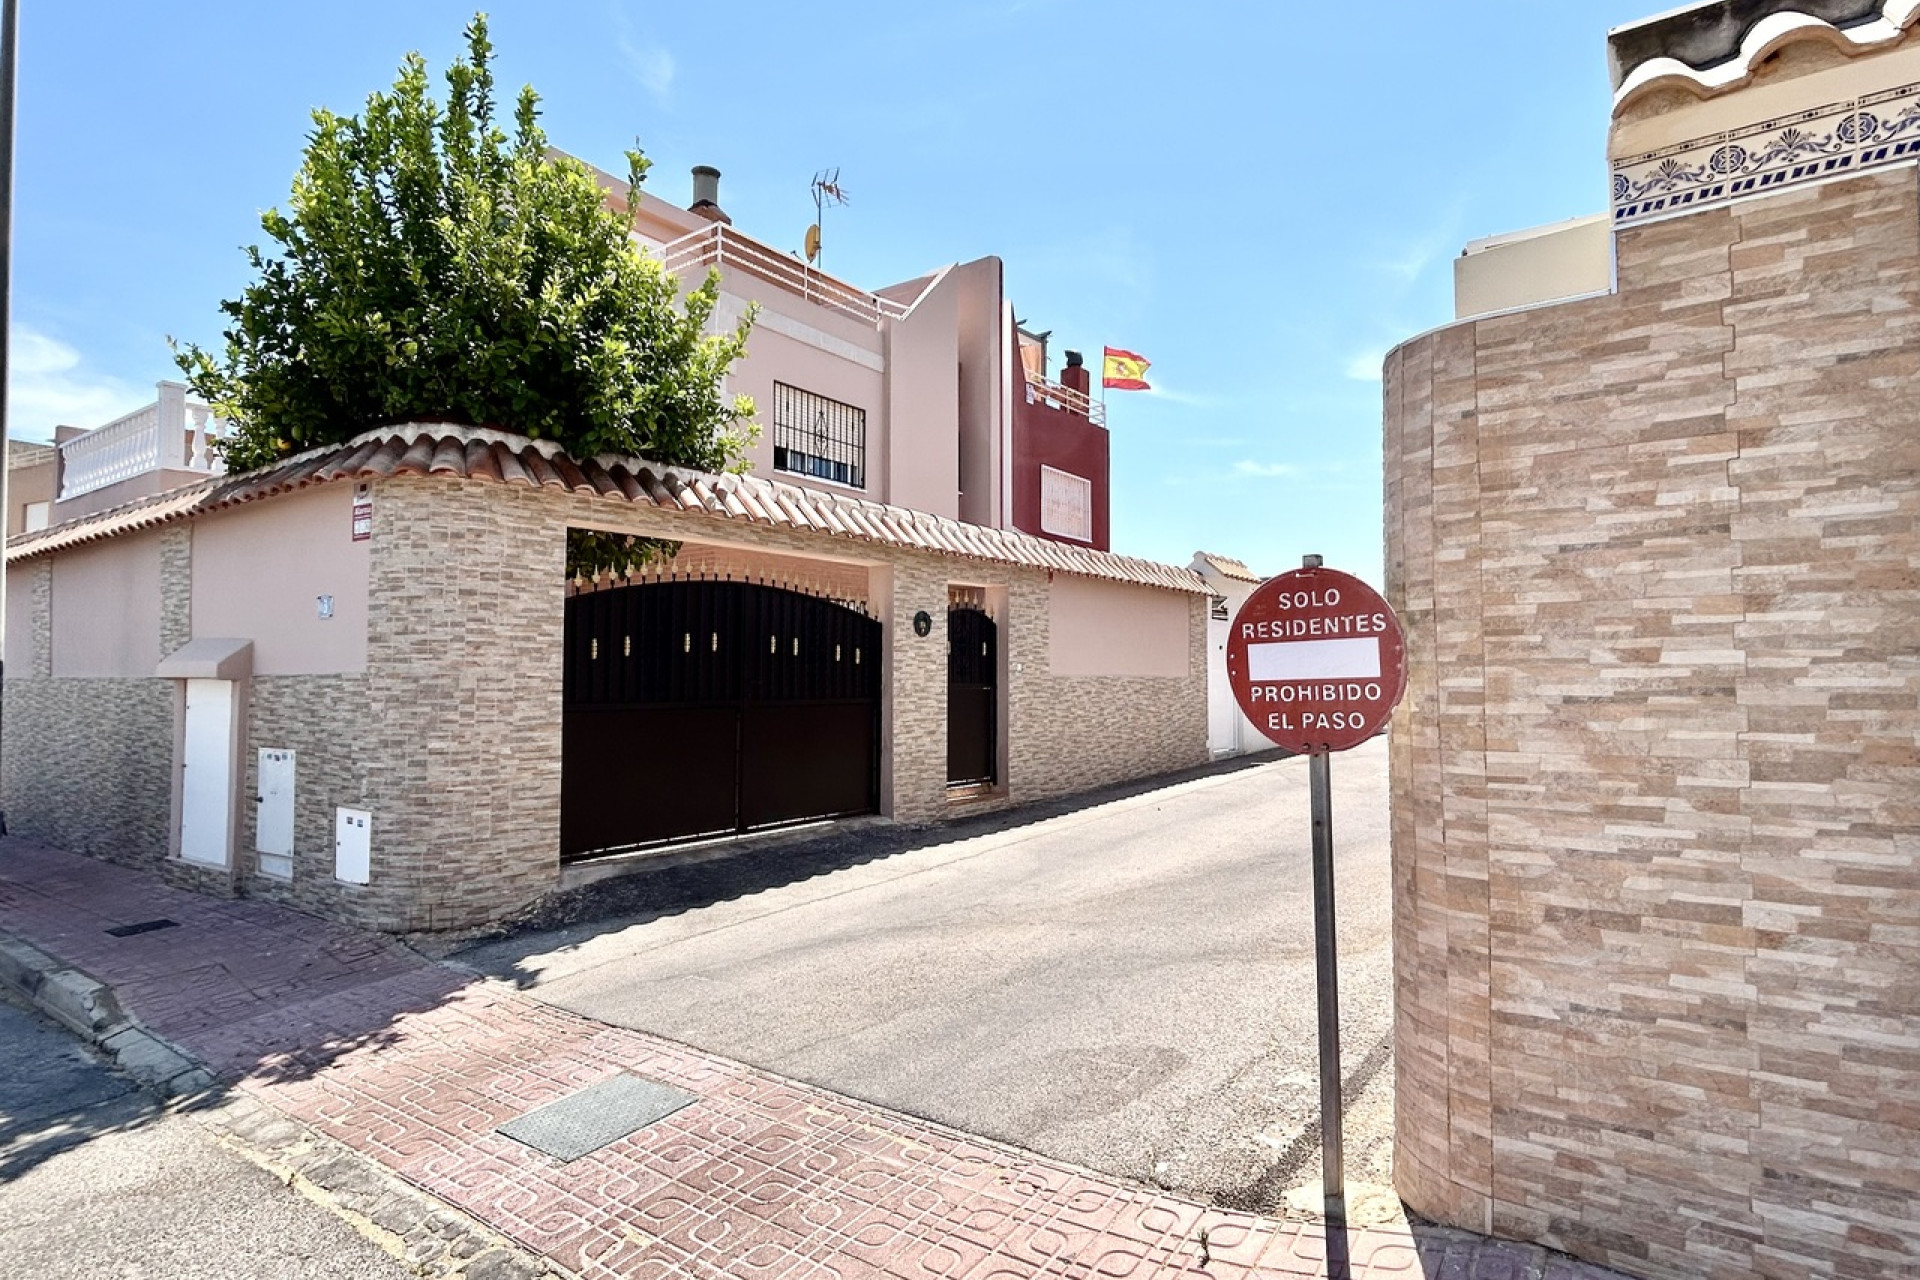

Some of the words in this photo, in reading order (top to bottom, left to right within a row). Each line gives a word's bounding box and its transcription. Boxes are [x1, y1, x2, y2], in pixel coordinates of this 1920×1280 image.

[1278, 588, 1341, 610] SOLO
[1241, 613, 1387, 639] RESIDENTES
[1250, 683, 1381, 702] PROHIBIDO
[1268, 712, 1294, 729] EL
[1301, 712, 1366, 729] PASO
